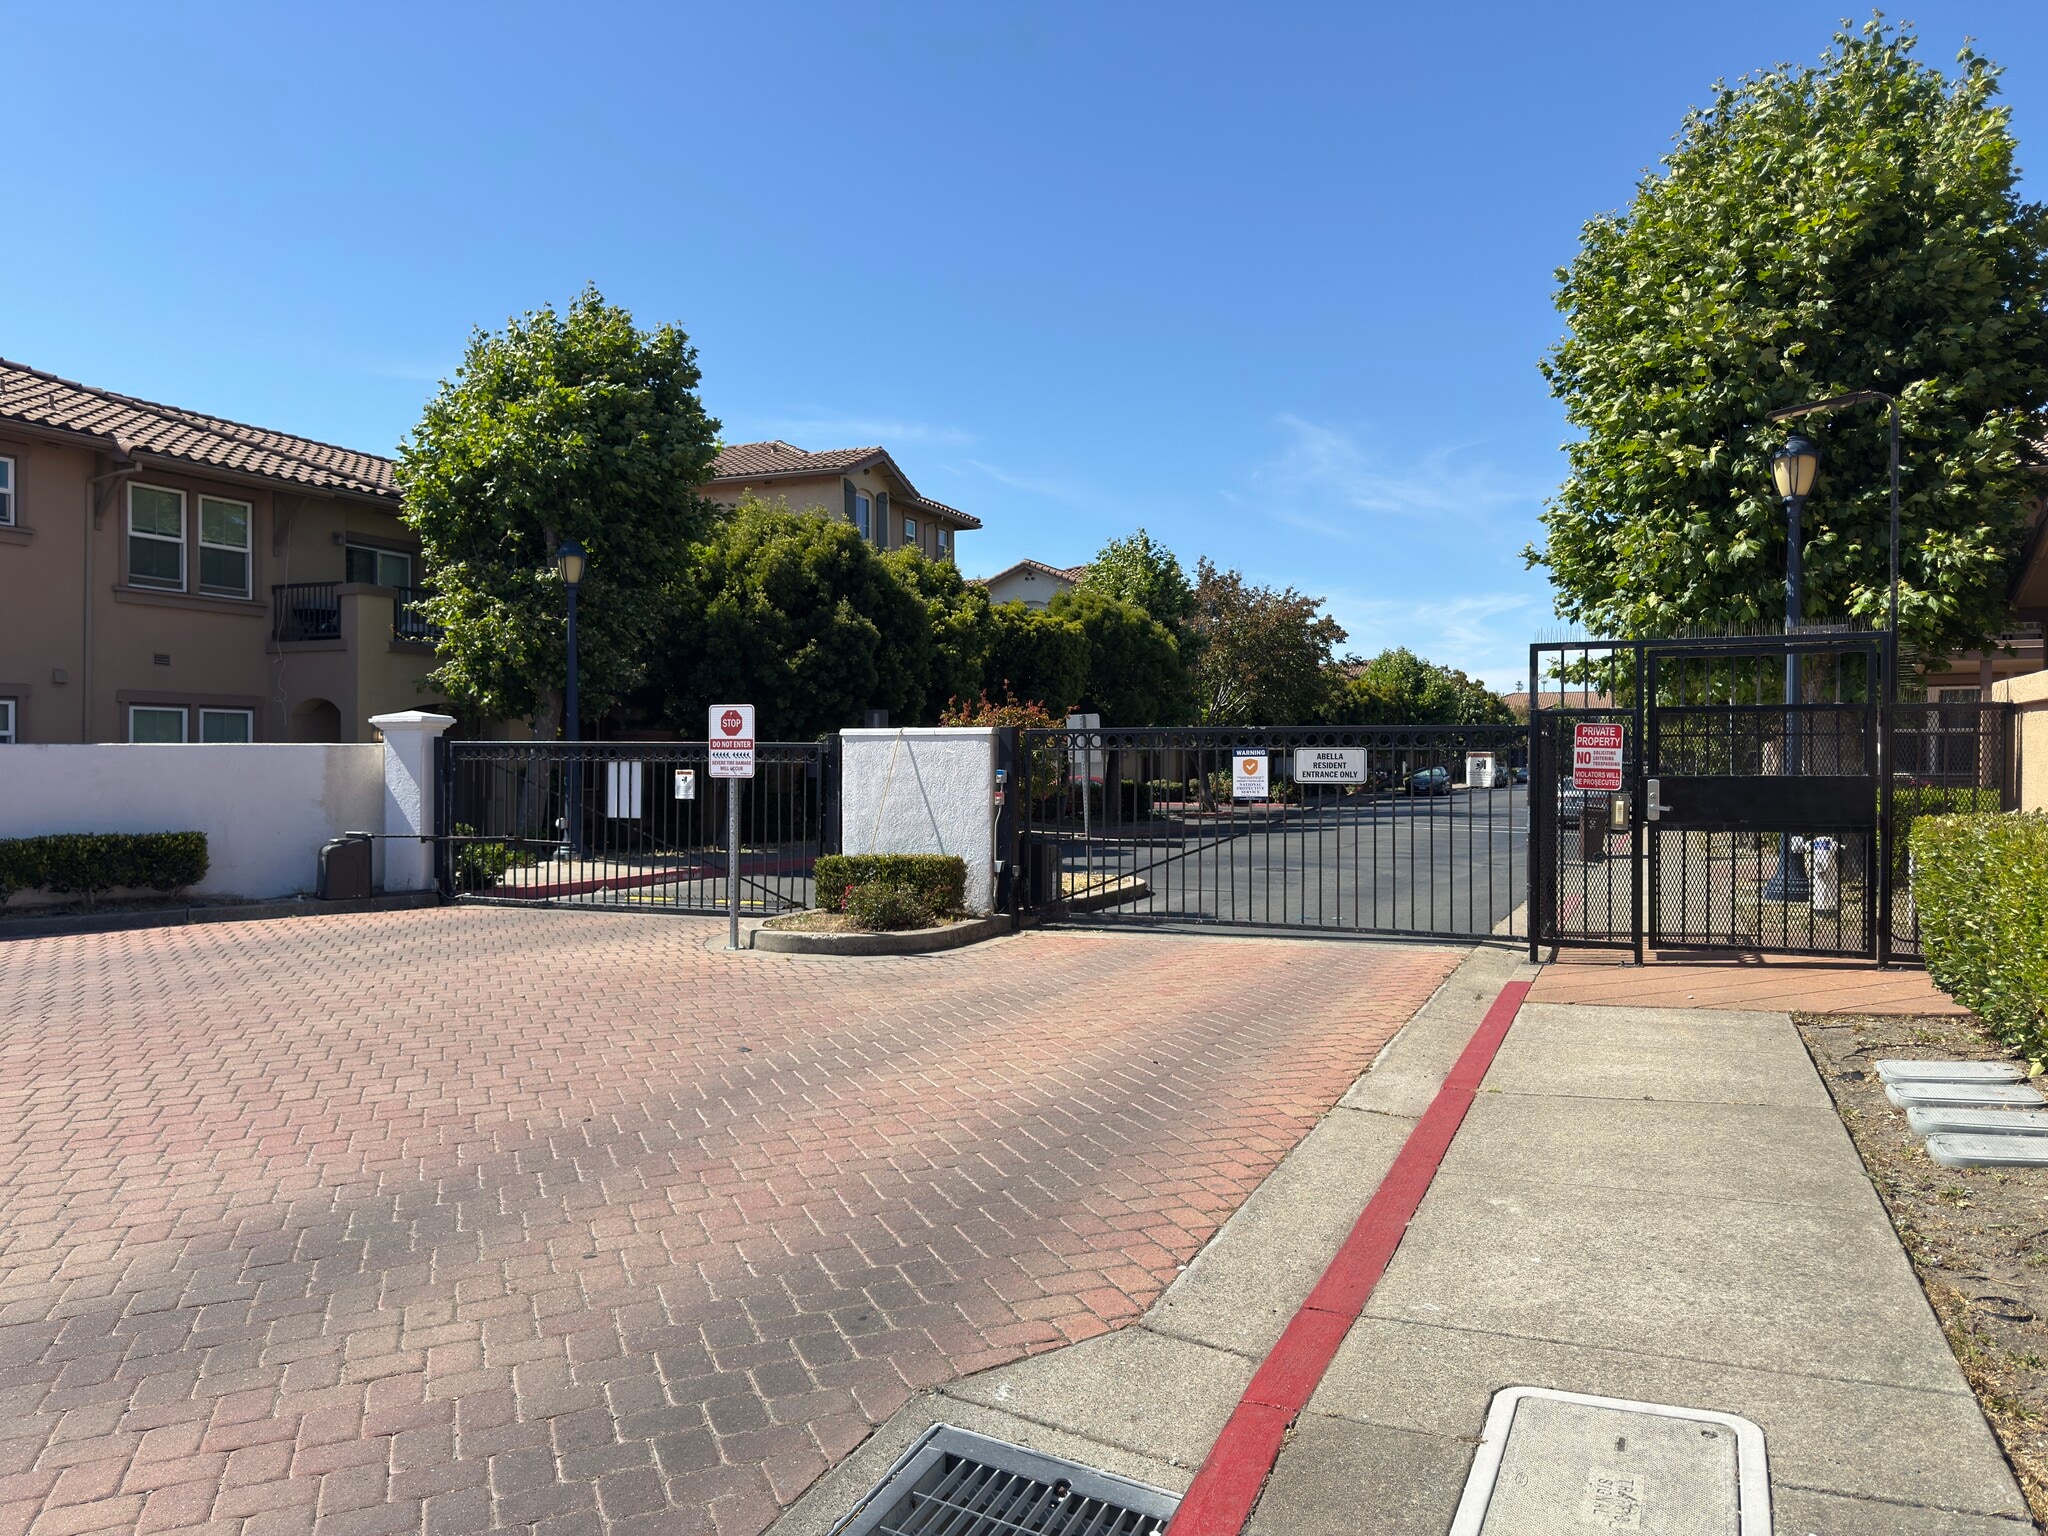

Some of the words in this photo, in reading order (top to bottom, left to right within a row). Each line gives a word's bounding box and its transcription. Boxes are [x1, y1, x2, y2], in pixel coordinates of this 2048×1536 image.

[722, 719, 741, 728] STOP
[1582, 726, 1616, 736] PRIVATE
[1576, 736, 1621, 747] PROPERTY
[1316, 752, 1344, 760] ABELLA
[1576, 751, 1592, 765] NO
[1312, 761, 1347, 769] RESIDENT
[1302, 770, 1338, 778] ENTRANCE
[1339, 770, 1358, 778] ONLY
